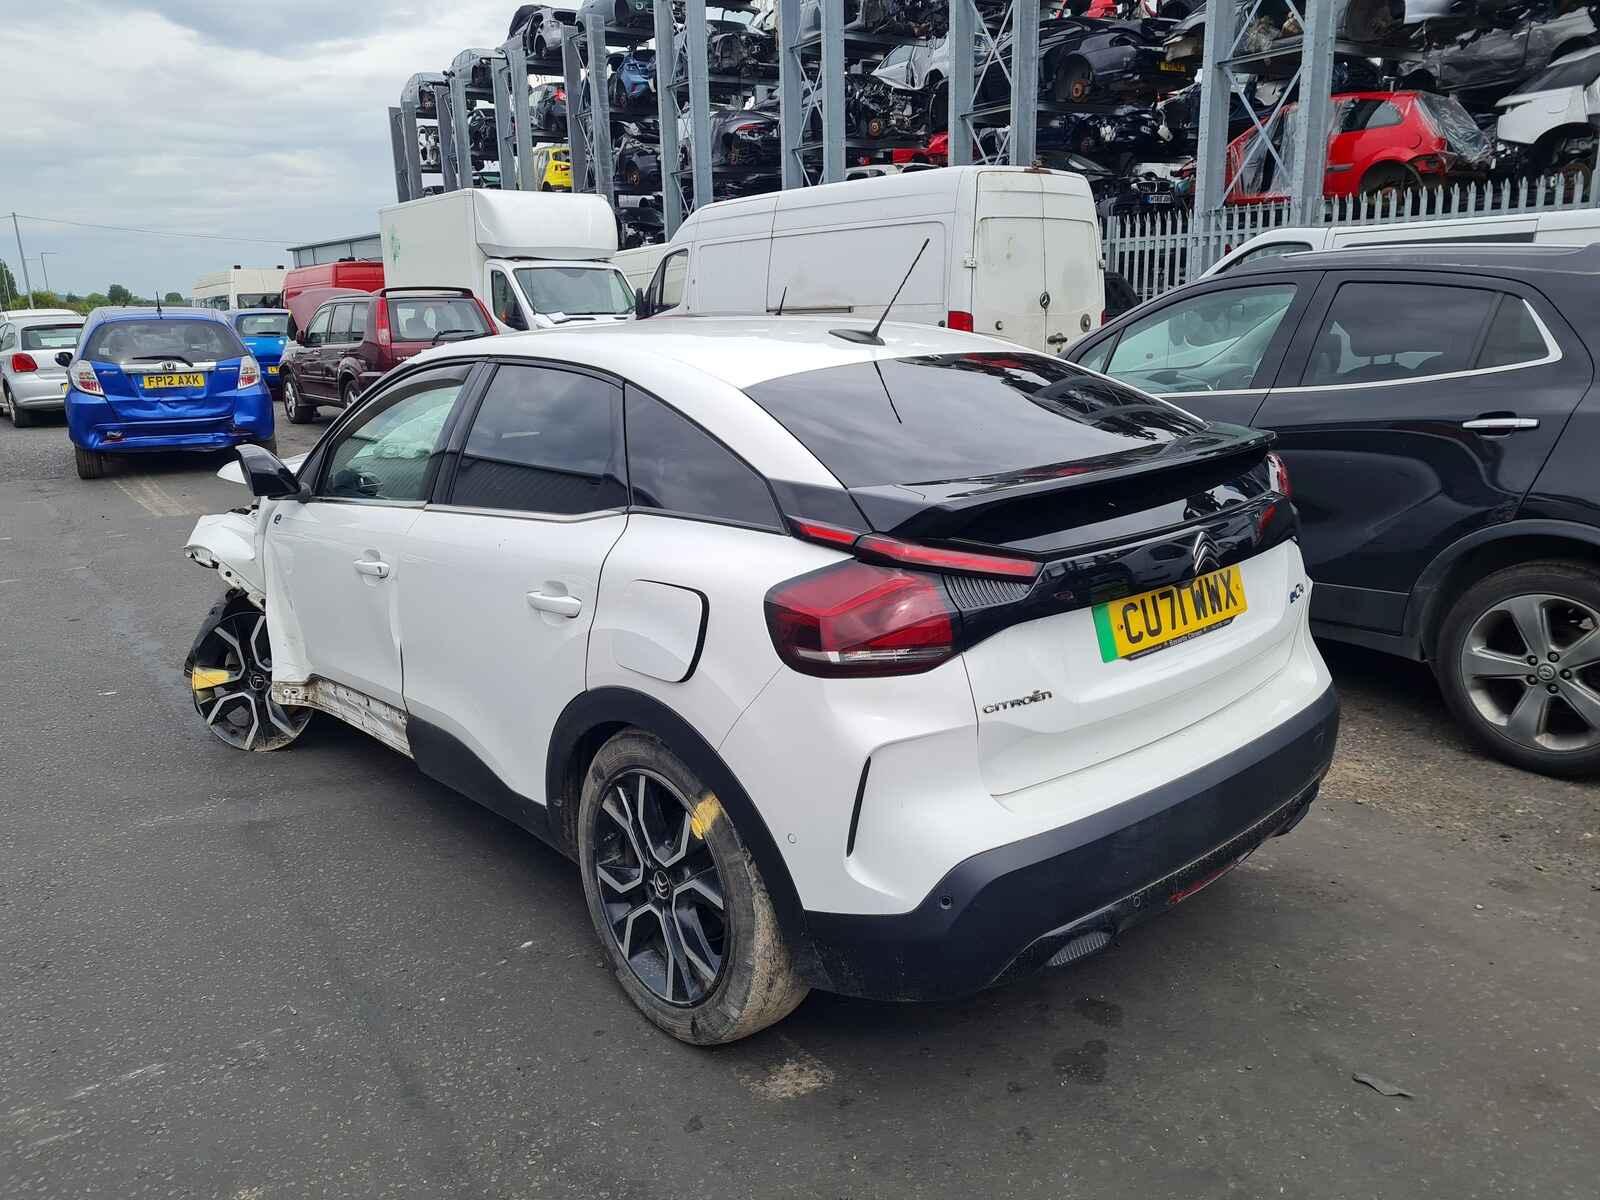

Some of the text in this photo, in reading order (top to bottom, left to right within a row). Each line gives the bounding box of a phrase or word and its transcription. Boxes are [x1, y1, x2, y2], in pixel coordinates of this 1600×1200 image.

[148, 375, 200, 386] FP12 AXK
[1122, 586, 1189, 644] CU71
[1191, 569, 1238, 621] WWX
